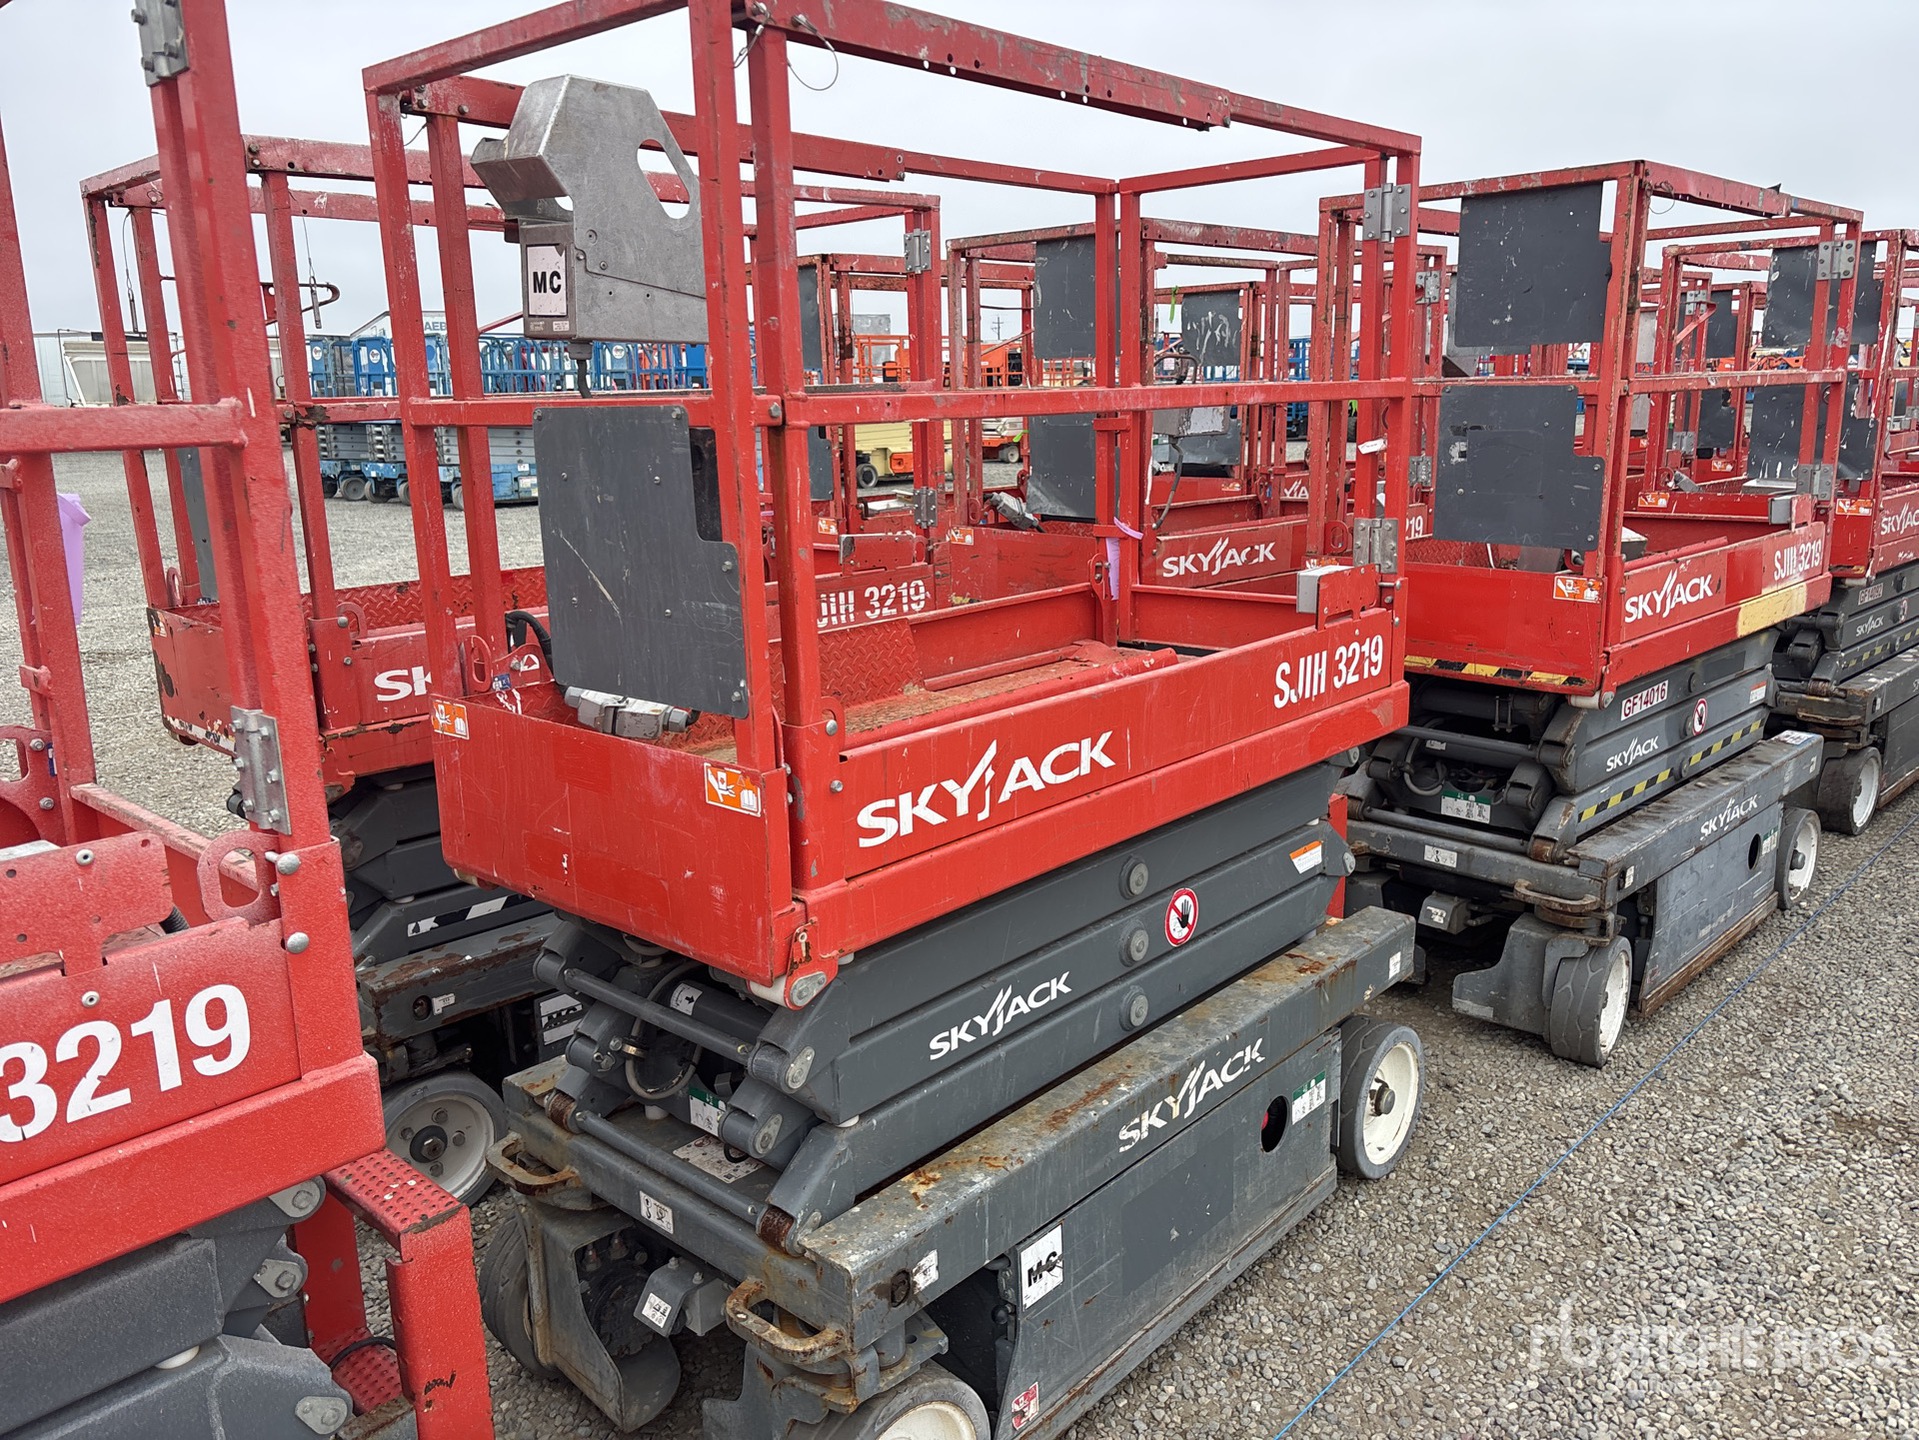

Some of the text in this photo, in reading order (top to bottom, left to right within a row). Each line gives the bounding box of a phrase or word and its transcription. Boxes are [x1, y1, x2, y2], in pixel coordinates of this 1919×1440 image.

[532, 270, 562, 294] MC
[1162, 536, 1276, 578] SKYJACK
[1799, 540, 1823, 572] 3219
[863, 579, 927, 619] 3219
[1624, 568, 1713, 624] SKYJACK
[1855, 615, 1885, 637] SKYJACK
[1333, 634, 1384, 689] 3219
[1622, 682, 1667, 718] GF14016
[1605, 736, 1660, 773] SKYJACK
[855, 730, 1116, 849] SKYJACK
[1700, 794, 1760, 842] SKYJACK
[928, 972, 1073, 1061] SKYJACK
[0, 983, 251, 1143] 3219
[1117, 1037, 1266, 1154] SKYJACK
[1027, 1250, 1062, 1289] MC
